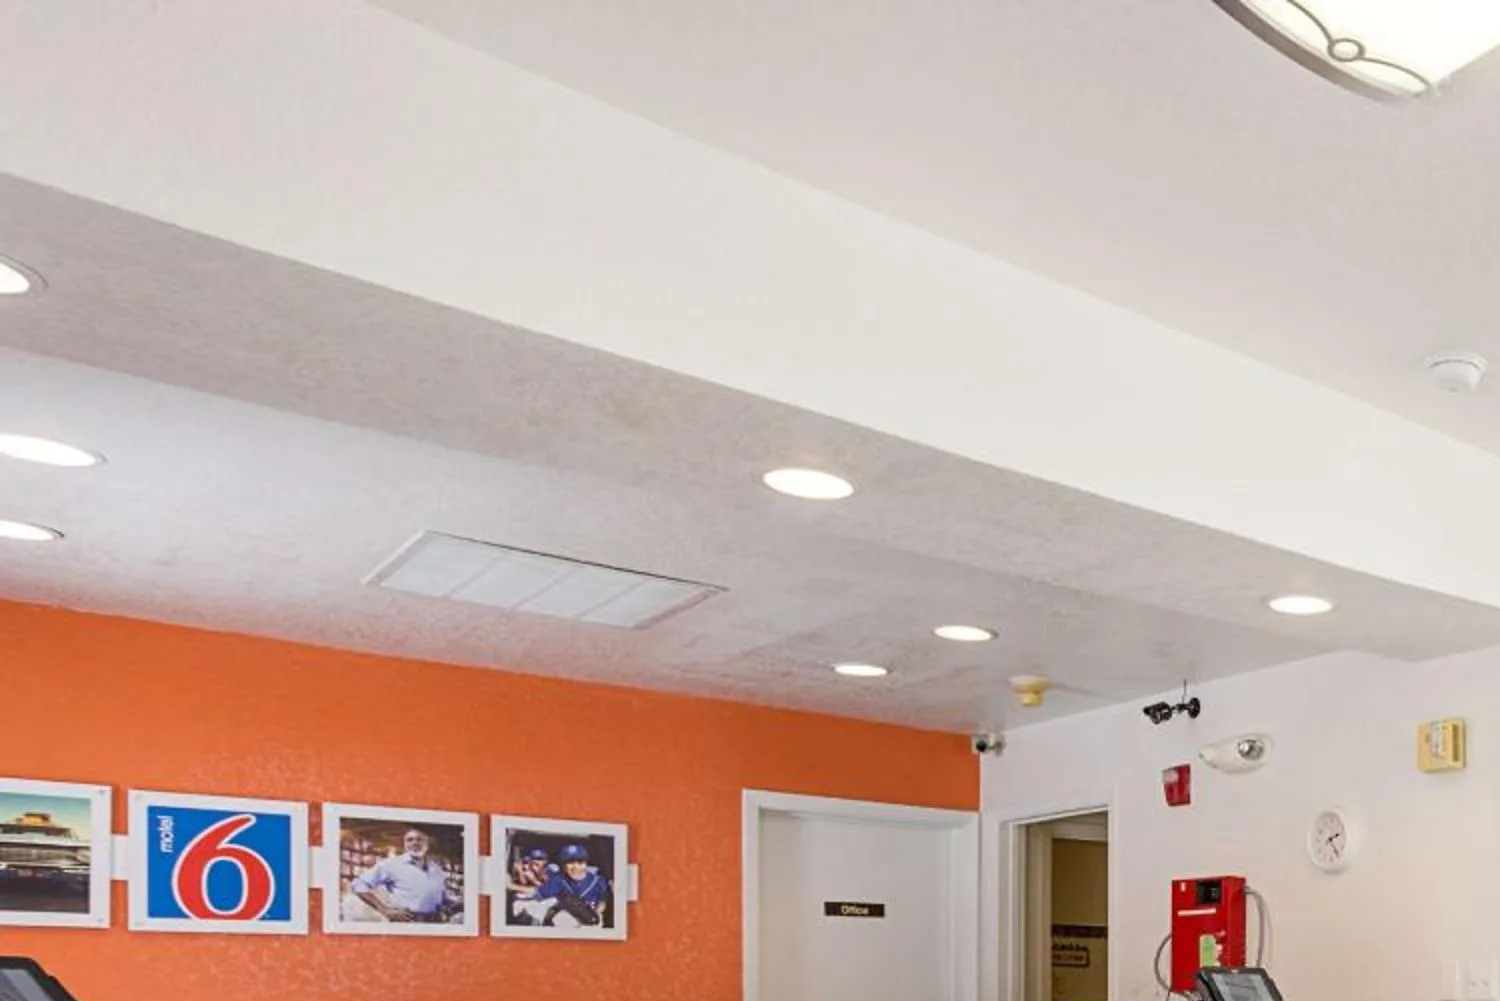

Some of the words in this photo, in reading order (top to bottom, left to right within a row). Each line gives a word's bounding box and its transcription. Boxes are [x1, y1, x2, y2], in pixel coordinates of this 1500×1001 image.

[156, 814, 175, 853] motel
[171, 813, 276, 921] 6
[840, 904, 870, 915] Office
